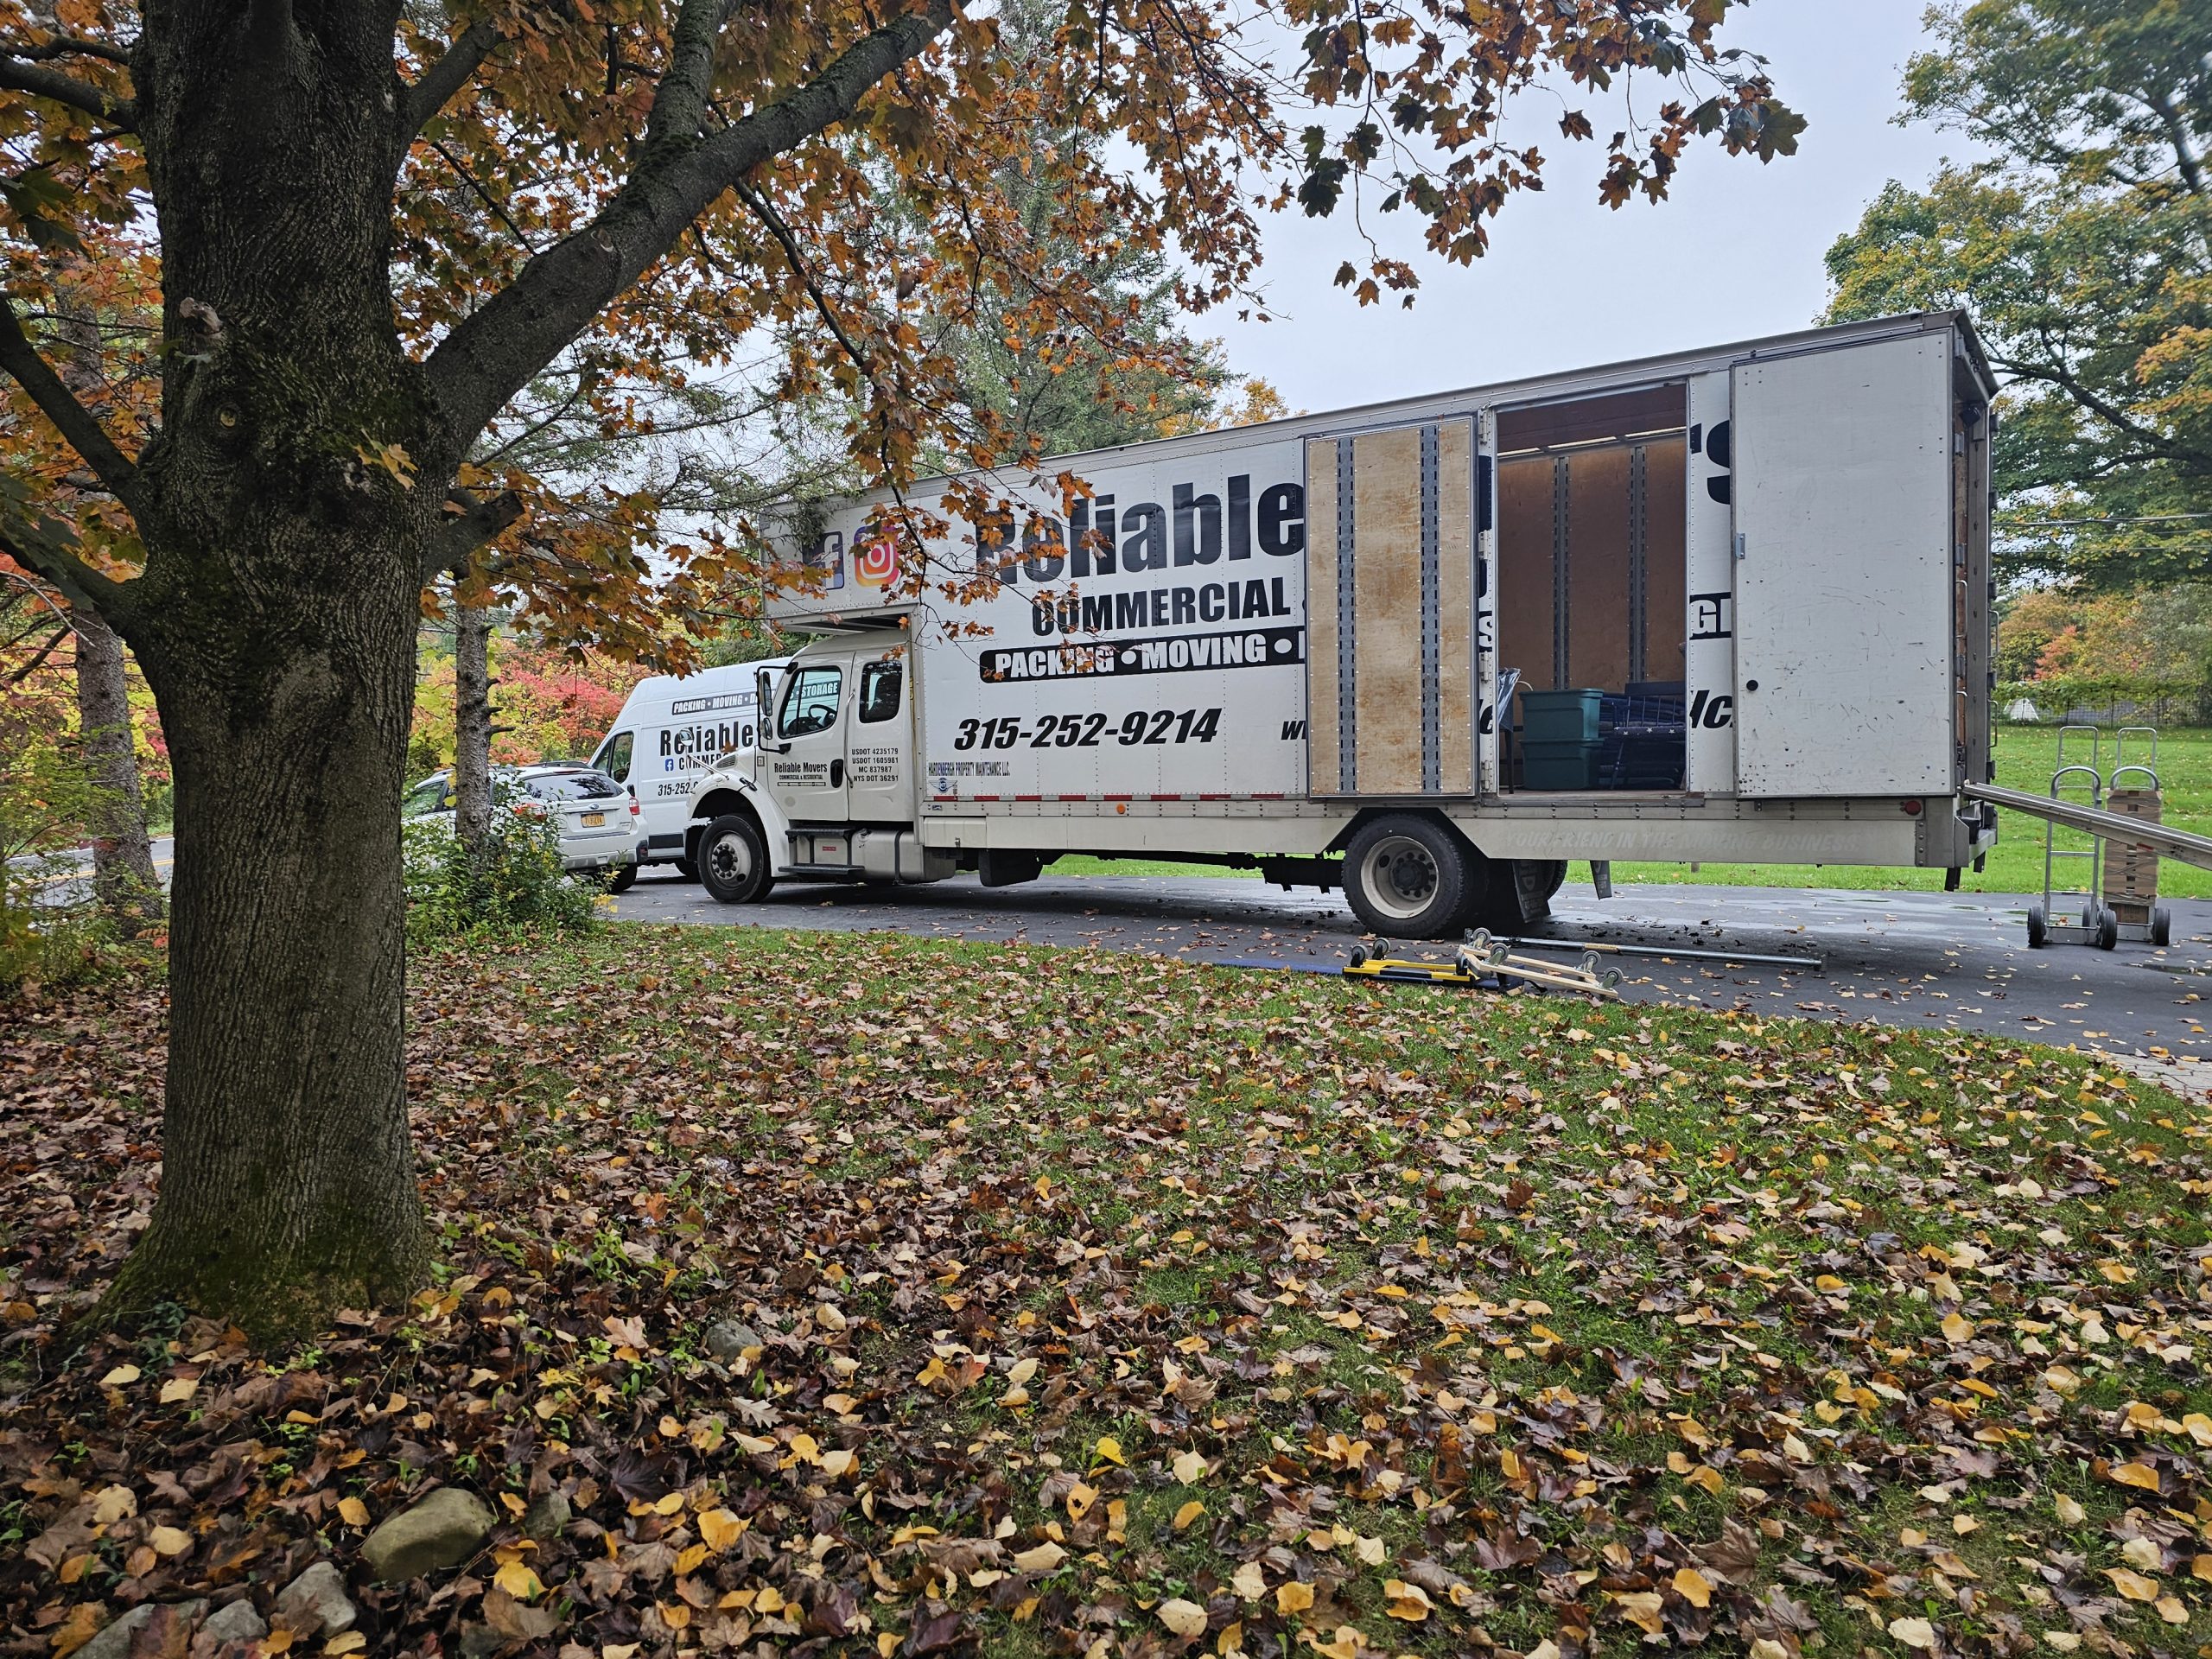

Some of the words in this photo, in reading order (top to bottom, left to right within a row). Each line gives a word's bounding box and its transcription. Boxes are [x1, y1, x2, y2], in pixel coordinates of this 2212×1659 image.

[975, 474, 1305, 585] Reliable
[1033, 577, 1290, 636] COMMERCIAL
[1141, 633, 1267, 670] MOVING
[674, 699, 706, 714] PACKING
[712, 695, 743, 709] MOVING
[801, 682, 839, 698] STORAGE
[953, 708, 1223, 751] 315-252-9214
[774, 762, 801, 773] Reliable
[803, 762, 828, 772] Movers
[956, 761, 975, 776] PROPERTY
